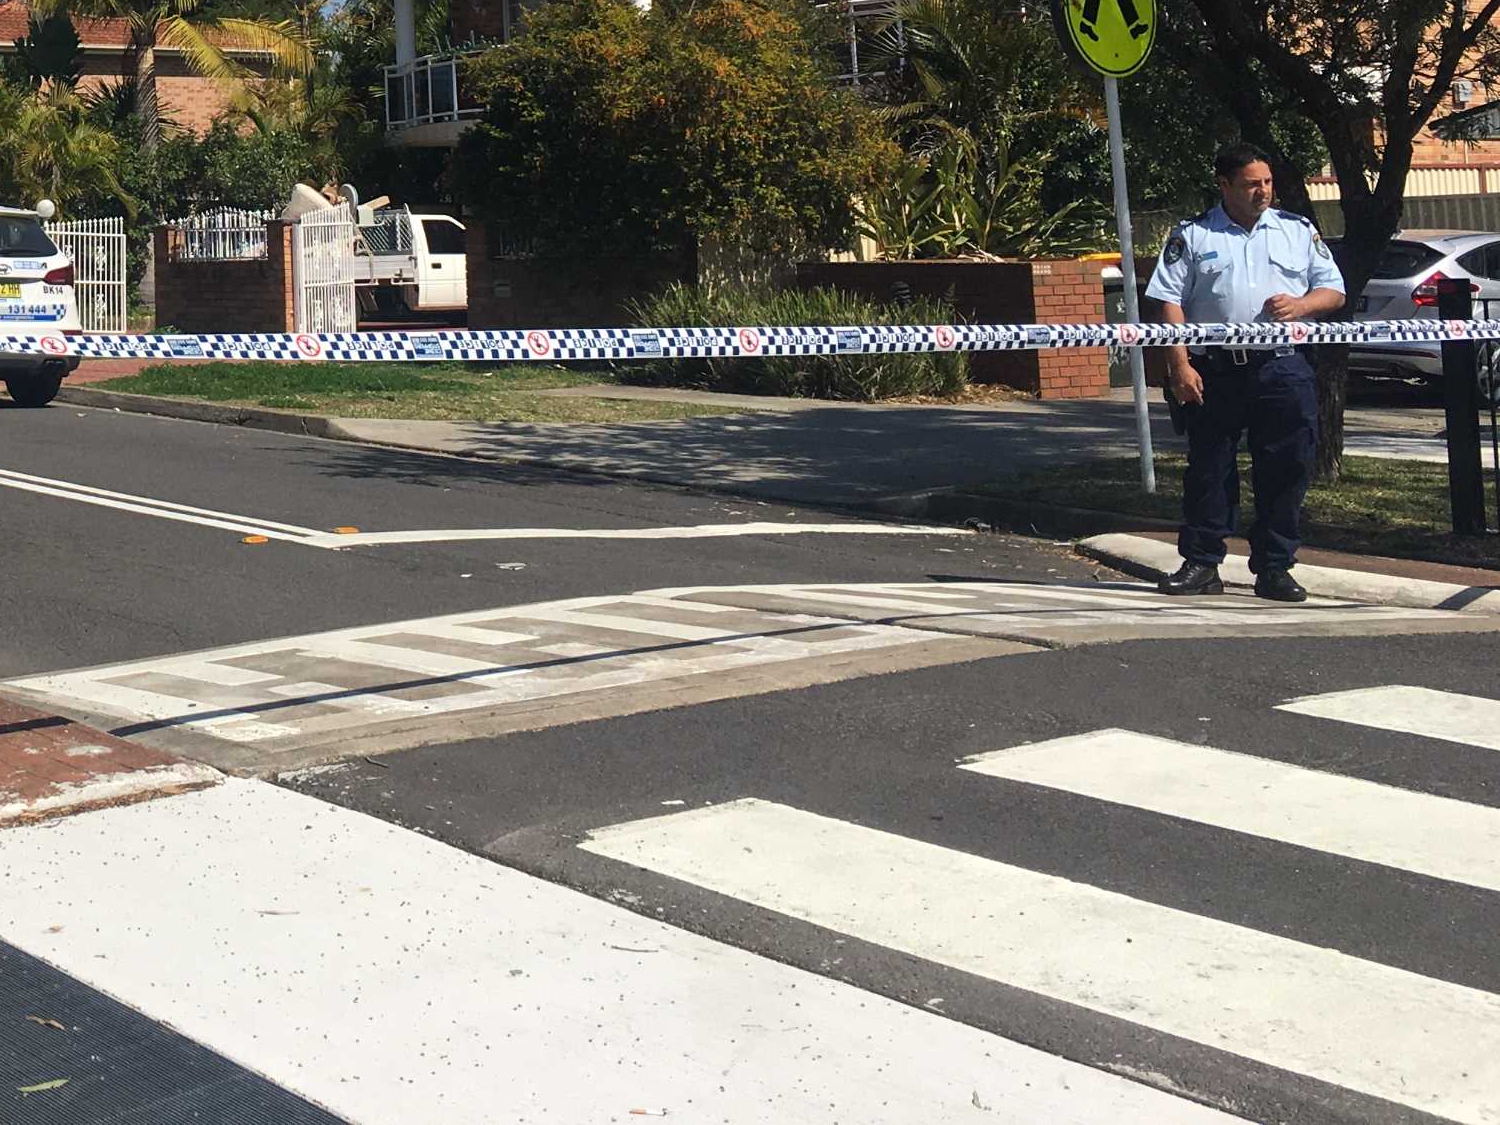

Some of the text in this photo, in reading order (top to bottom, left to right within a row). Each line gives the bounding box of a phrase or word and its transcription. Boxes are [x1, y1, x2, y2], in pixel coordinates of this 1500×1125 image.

[43, 286, 63, 295] BK14
[221, 342, 271, 351] POLICE
[573, 338, 617, 348] POLICE
[676, 337, 718, 347] POLICE
